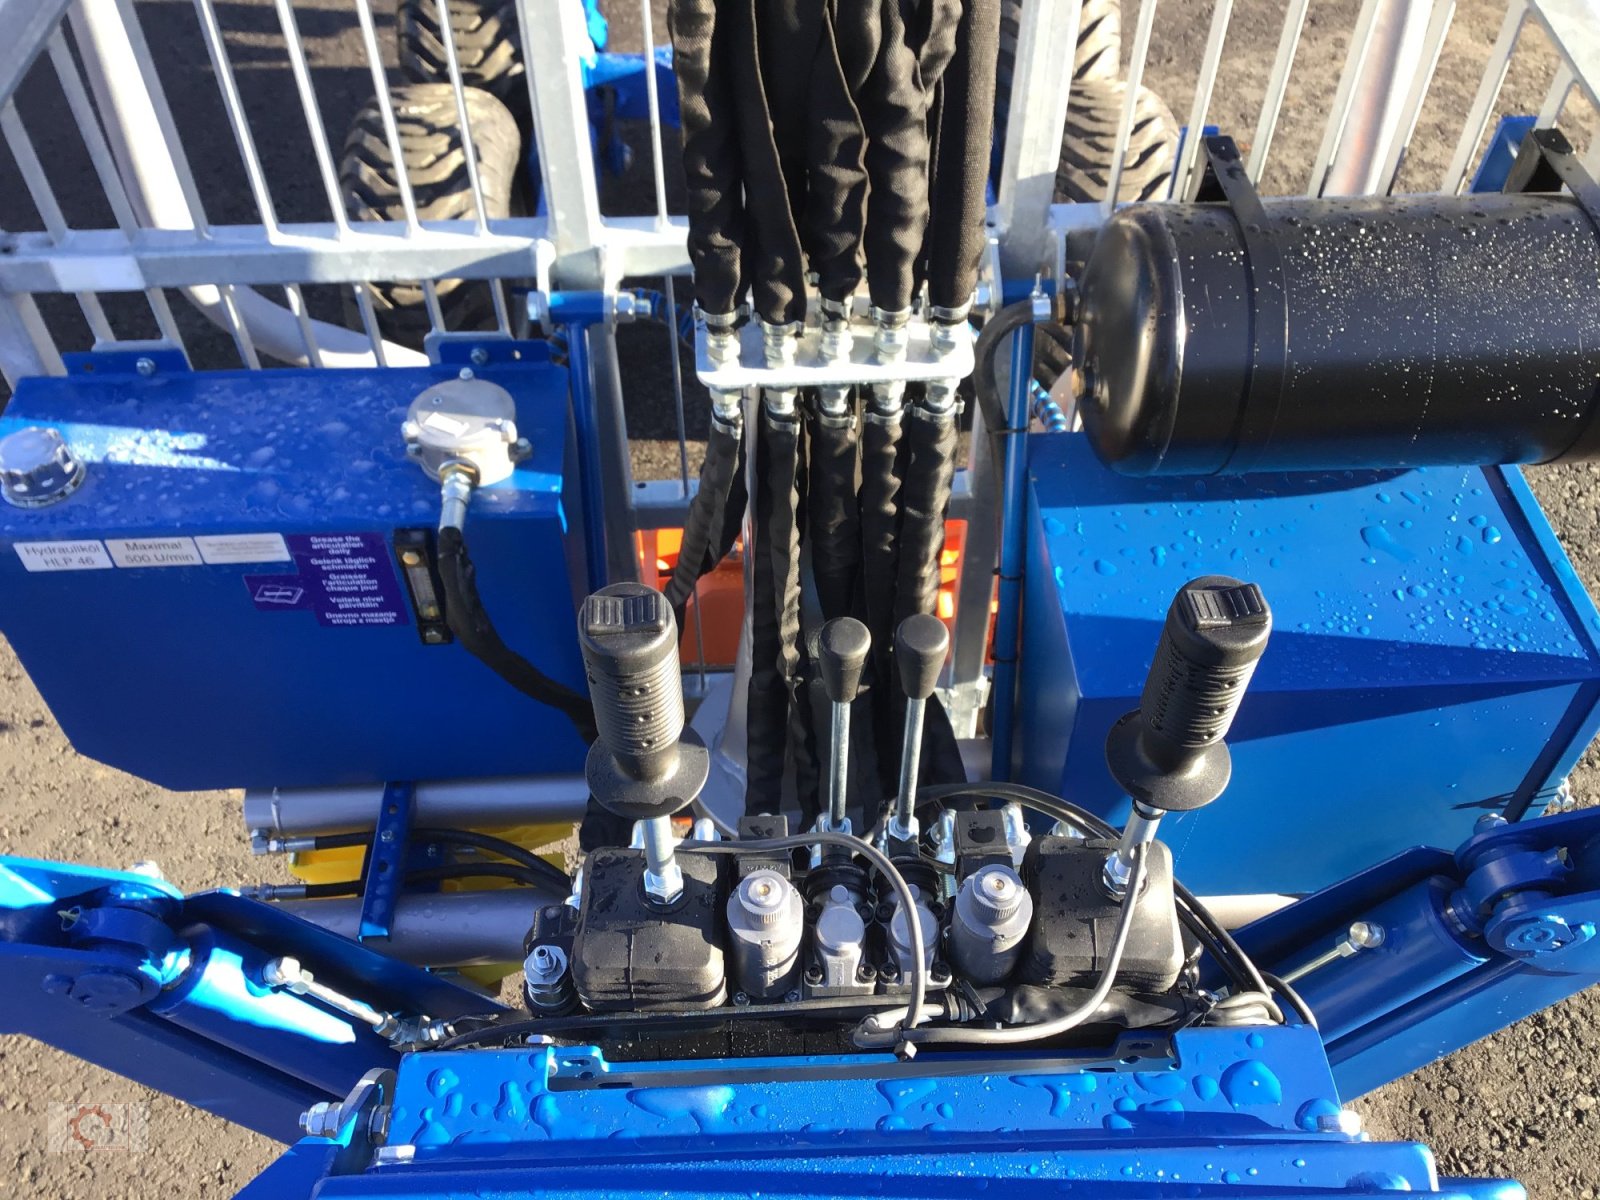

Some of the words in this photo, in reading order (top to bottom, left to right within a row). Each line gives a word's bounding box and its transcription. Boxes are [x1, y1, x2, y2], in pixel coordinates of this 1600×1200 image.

[24, 543, 101, 557] Hydrauliköl
[124, 541, 182, 552] Maximal
[43, 557, 73, 568] HLP
[77, 556, 95, 566] 46
[124, 553, 151, 564] 500
[153, 552, 194, 564] U/min
[310, 557, 342, 565] Gelenk
[329, 572, 366, 580] Graisser
[361, 611, 397, 619] mazanje
